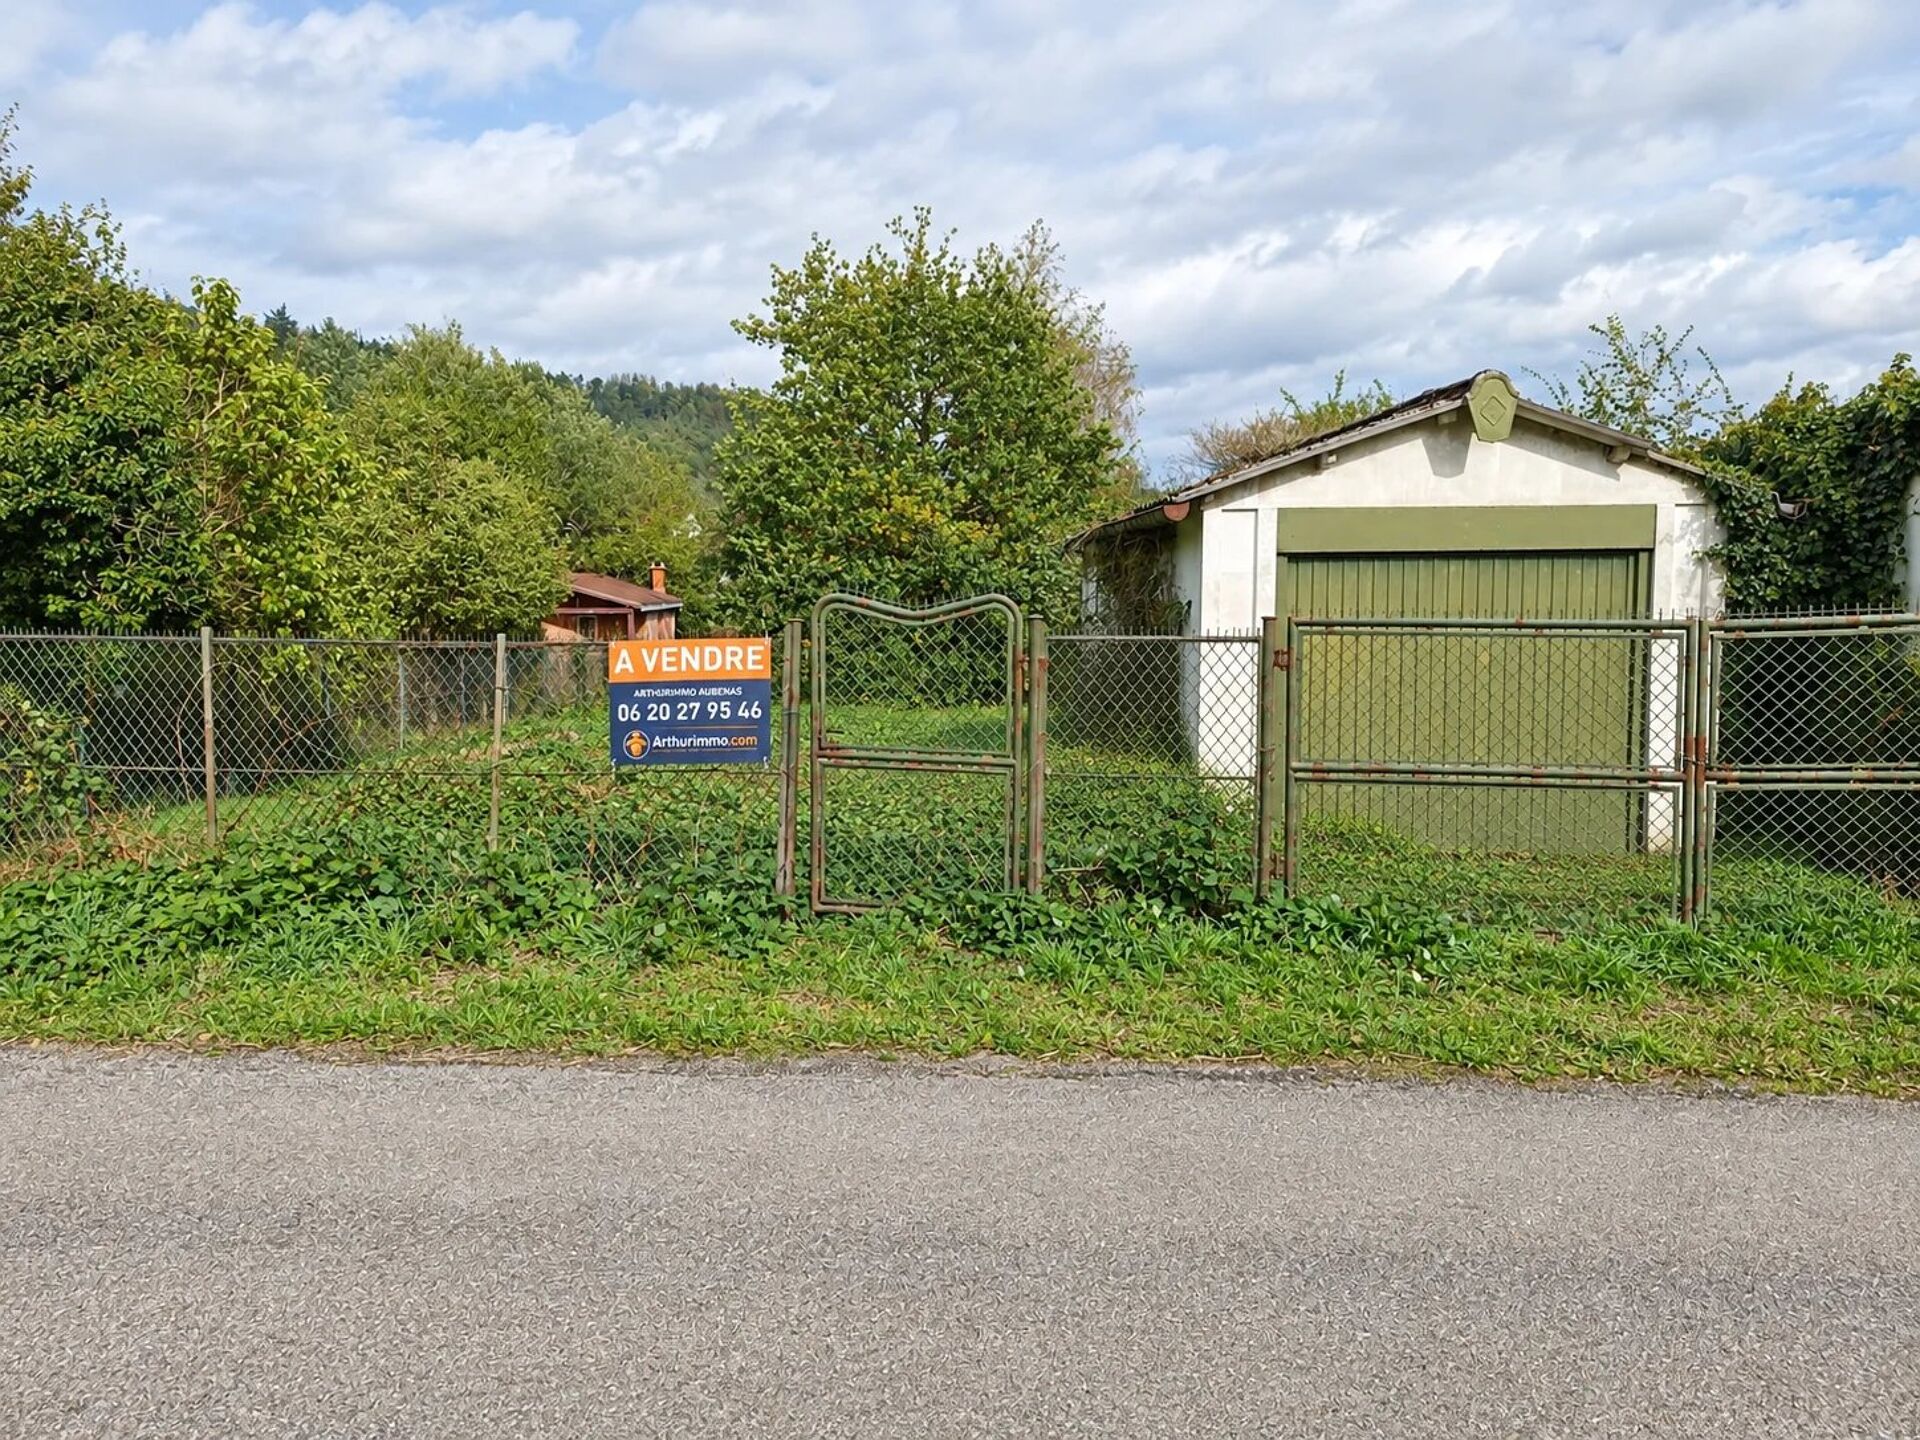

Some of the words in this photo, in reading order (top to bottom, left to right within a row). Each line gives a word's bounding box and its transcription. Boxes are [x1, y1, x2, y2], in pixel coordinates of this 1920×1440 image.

[614, 648, 634, 674] A
[641, 645, 764, 673] VENDRE
[698, 687, 743, 696] AUBENAS
[617, 703, 641, 722] 06
[647, 703, 671, 721] 20
[677, 702, 700, 720] 27
[707, 701, 731, 719] 95
[737, 700, 762, 719] 46
[652, 734, 758, 748] Arthurimmo.com
